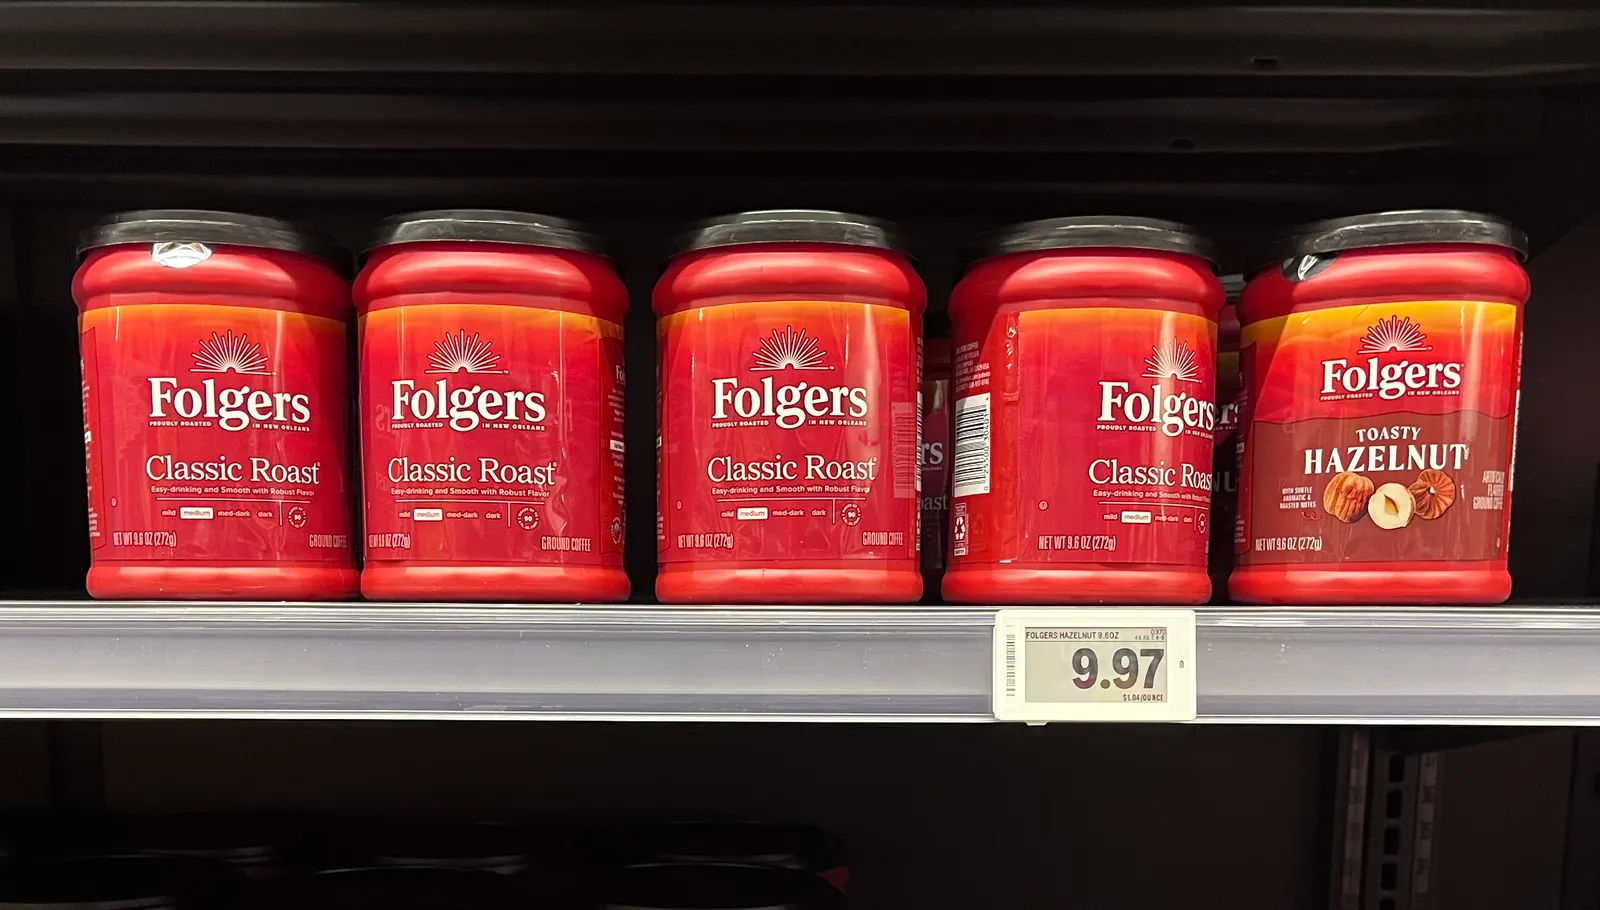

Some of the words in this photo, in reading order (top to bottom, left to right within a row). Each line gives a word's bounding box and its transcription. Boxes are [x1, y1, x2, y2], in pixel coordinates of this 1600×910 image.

[1320, 357, 1461, 399] Folgers
[148, 377, 310, 431] Folgers
[392, 379, 546, 432] Folgers
[712, 377, 868, 428] Folgers
[1097, 381, 1214, 437] Folgers
[1356, 426, 1421, 442] TOASTY
[1304, 444, 1466, 474] HAZELNUT
[146, 454, 243, 481] Classic
[250, 458, 319, 484] Roast
[388, 457, 472, 482] Classic
[479, 458, 556, 485] Roast
[708, 454, 798, 482] Classic
[805, 455, 875, 480] Roast
[1089, 458, 1176, 486] Classic
[1180, 463, 1212, 491] Roas
[151, 486, 202, 494] Easy-drinking
[391, 488, 433, 496] Easy-drinking
[712, 486, 758, 495] Easy-drinking
[1093, 489, 1144, 498] Easy-drinking
[123, 532, 133, 546] WT
[133, 532, 144, 545] 9.6
[145, 532, 153, 545] OZ
[154, 532, 177, 547] (272g)
[309, 534, 332, 547] GROUND
[542, 536, 570, 550] GROUND
[571, 538, 591, 552] COFFEE
[695, 534, 704, 547] 9.6
[705, 534, 713, 547] OZ
[714, 534, 733, 548] (272g)
[862, 532, 888, 545] GROUND
[889, 532, 903, 545] COFFEE
[1038, 536, 1052, 549] NET
[1054, 536, 1066, 549] WT
[1067, 536, 1079, 549] 9.6
[1081, 536, 1091, 549] OZ
[1092, 536, 1116, 551] (272g)
[1266, 538, 1275, 551] WT
[1276, 537, 1286, 550] 9.6
[1287, 537, 1297, 550] OZ
[1298, 536, 1322, 551] (272g)
[1072, 648, 1164, 689] 9.97
